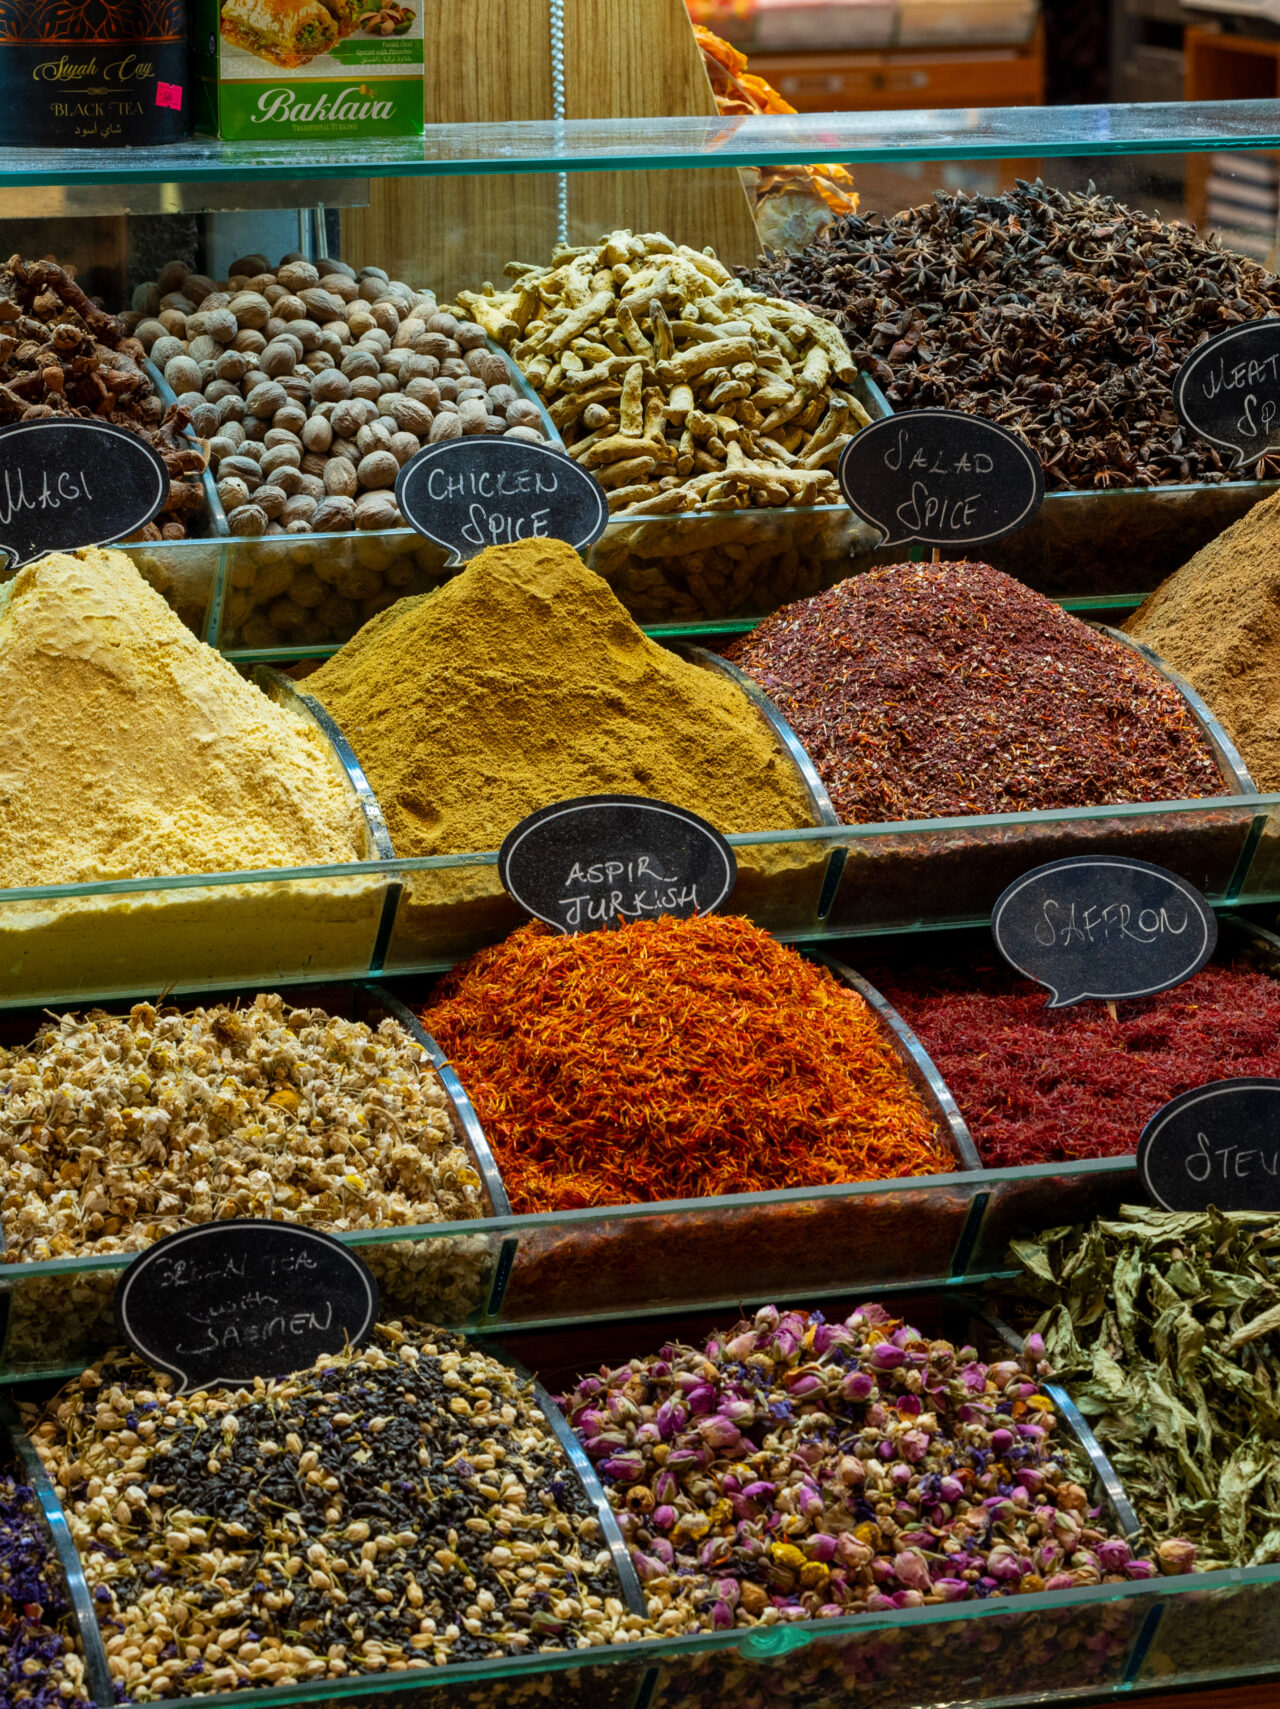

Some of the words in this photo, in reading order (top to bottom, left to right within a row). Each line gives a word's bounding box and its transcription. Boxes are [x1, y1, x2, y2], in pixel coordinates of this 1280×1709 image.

[50, 102, 104, 117] BLACK
[109, 102, 144, 116] TEA
[250, 87, 397, 123] Baklava
[74, 122, 98, 137] أسود
[100, 124, 122, 139] شاي
[884, 429, 994, 474] SALAD
[428, 468, 559, 500] CHICKEN
[896, 481, 982, 530] SPICE
[461, 503, 550, 545] SPICE
[565, 856, 678, 886] ASPIR
[1034, 899, 1188, 946] SAFFRON
